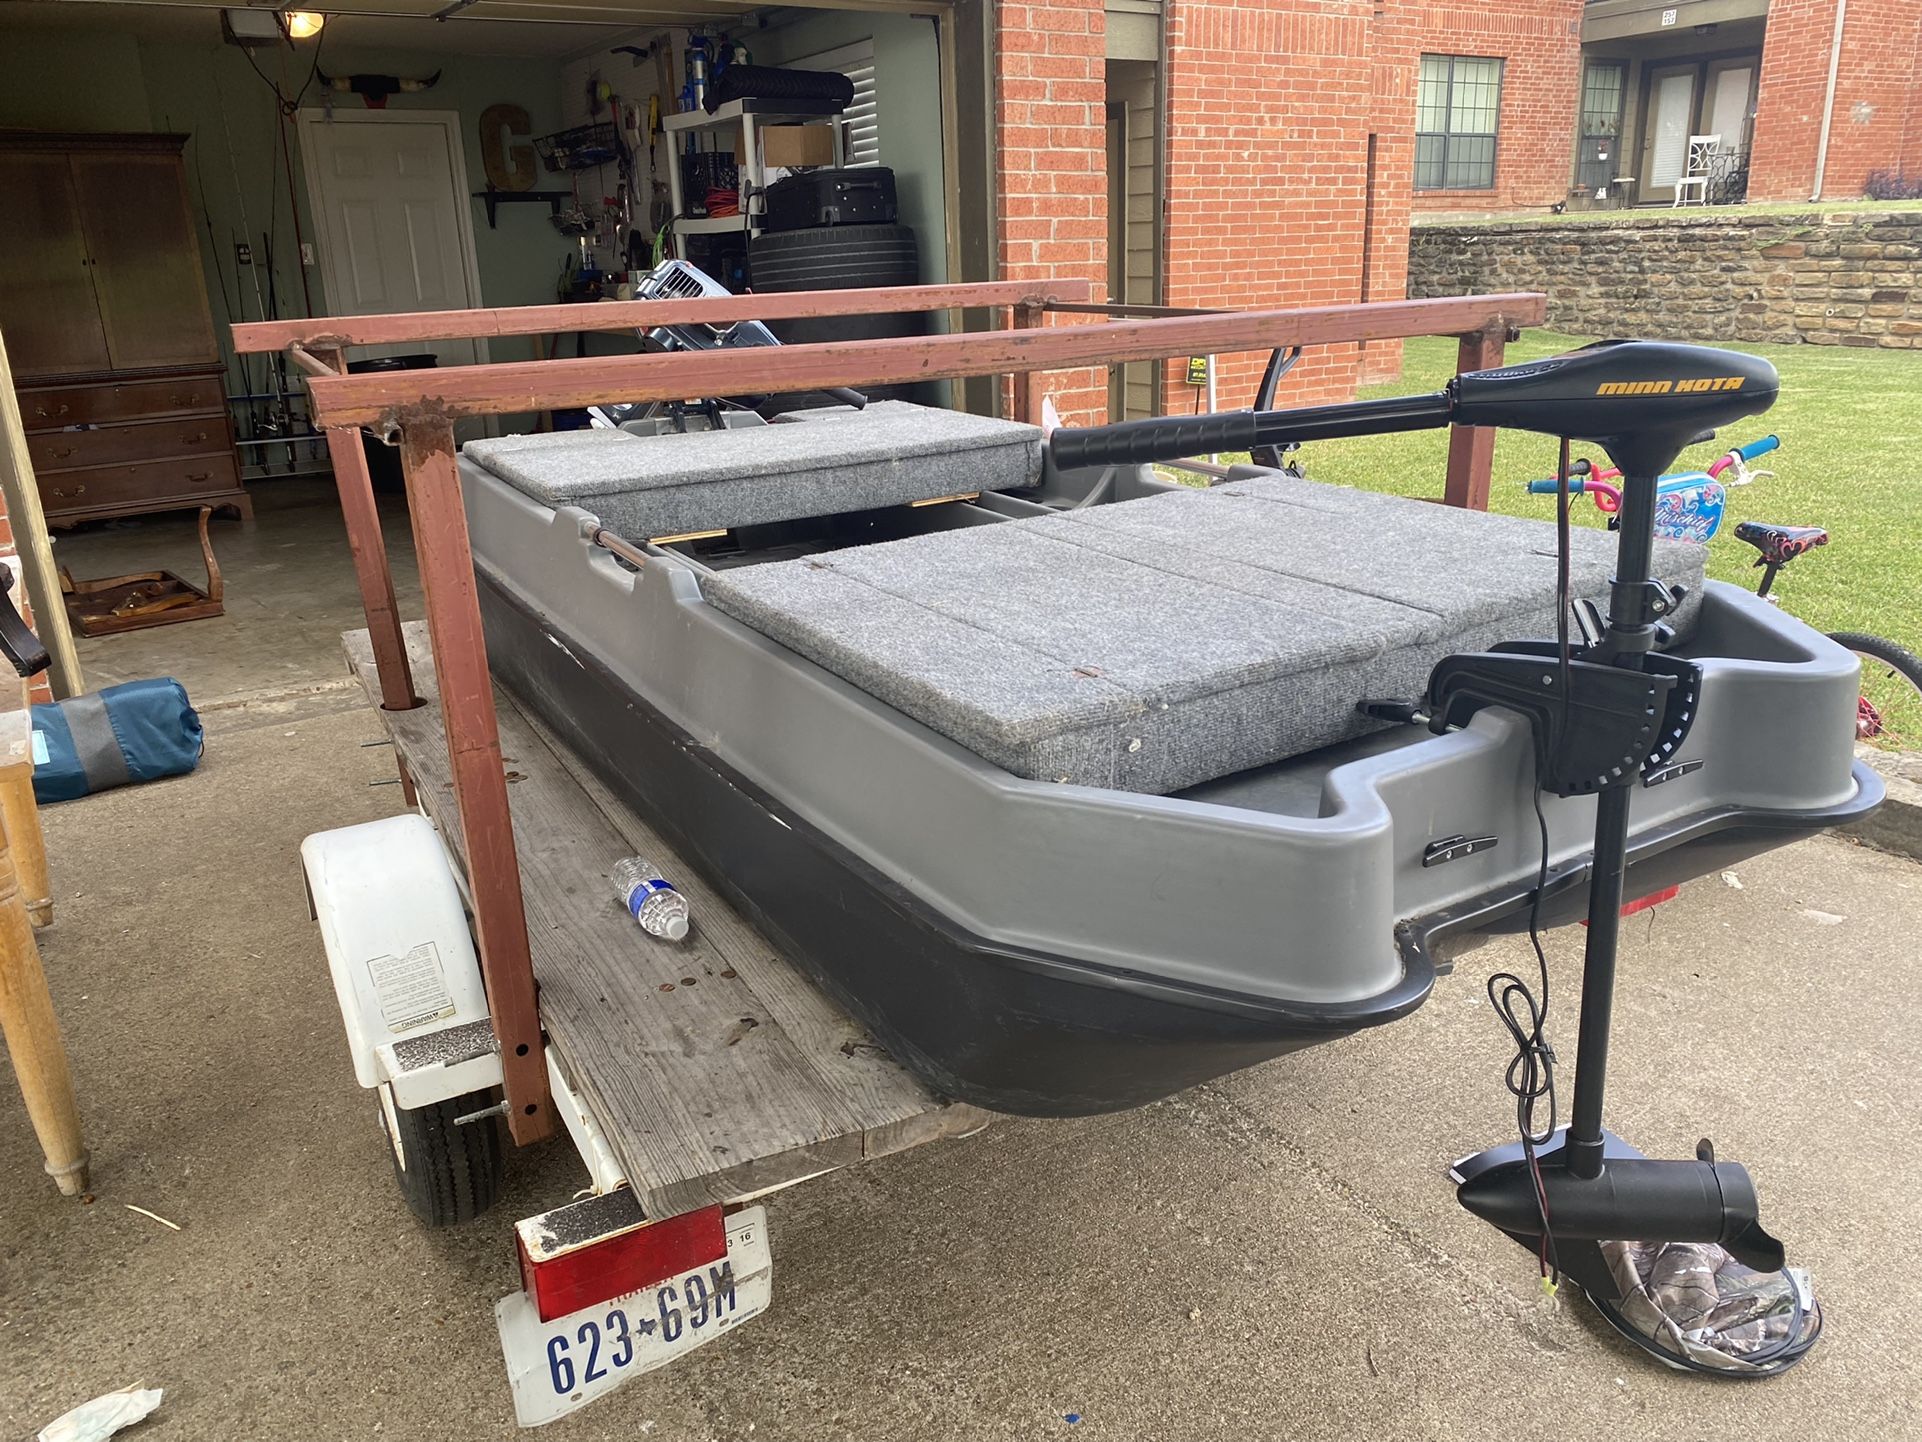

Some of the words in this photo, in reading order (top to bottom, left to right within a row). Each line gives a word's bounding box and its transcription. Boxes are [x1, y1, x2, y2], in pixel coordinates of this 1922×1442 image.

[479, 103, 538, 192] G
[1596, 380, 1673, 395] MINN
[1674, 376, 1746, 393] KOTA
[401, 1013, 434, 1029] WARNING
[740, 1232, 751, 1242] 16
